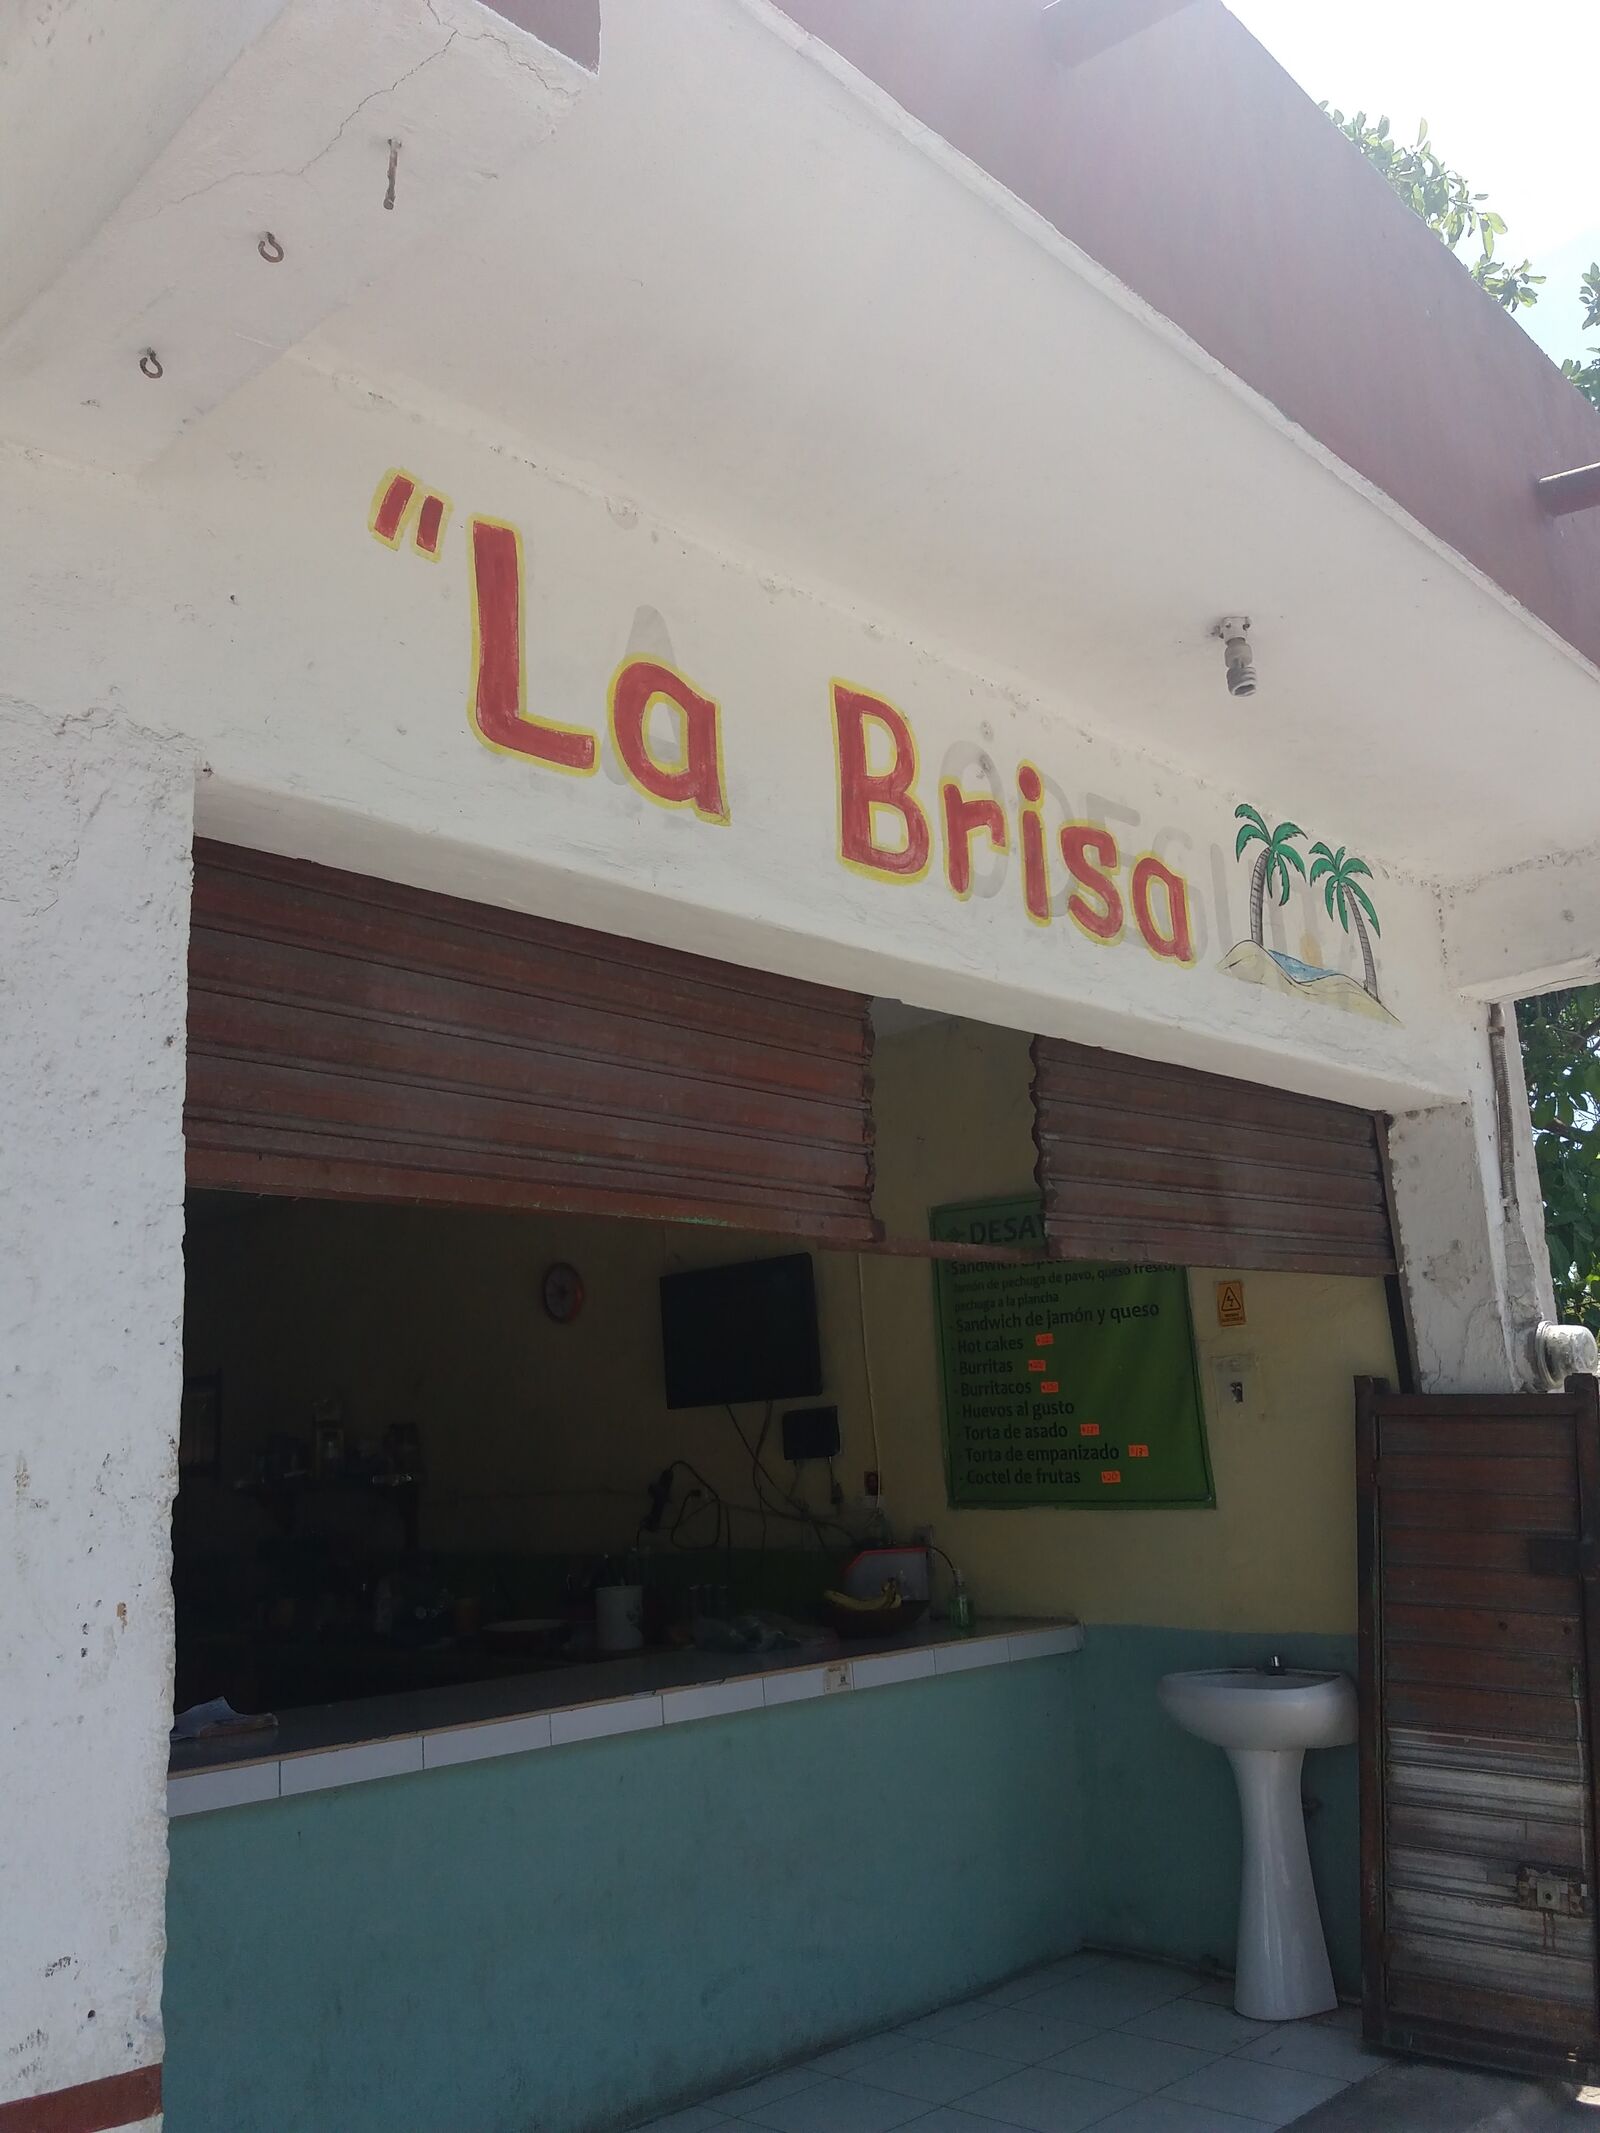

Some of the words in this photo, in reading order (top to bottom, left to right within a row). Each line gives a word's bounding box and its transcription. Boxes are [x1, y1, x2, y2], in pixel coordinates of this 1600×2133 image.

[829, 676, 1197, 968] Brisa
[986, 1279, 1000, 1290] de
[1002, 1275, 1046, 1292] pechuga
[1047, 1271, 1062, 1284] de
[1097, 1265, 1131, 1281] queso
[954, 1299, 996, 1313] pechuga
[998, 1297, 1005, 1307] a
[1006, 1295, 1016, 1307] la
[1017, 1291, 1059, 1309] plancha
[956, 1310, 1022, 1333] Sandwich
[1025, 1310, 1043, 1326] de
[1046, 1307, 1093, 1330] jamón
[1097, 1308, 1106, 1326] y
[1110, 1302, 1160, 1323] queso
[957, 1338, 982, 1354] Hot
[985, 1335, 1024, 1352] cakes
[959, 1358, 1014, 1376] Burritas
[960, 1380, 1032, 1397] Burritacos
[962, 1403, 1013, 1419] Huevos
[1016, 1401, 1029, 1417] al
[1032, 1400, 1075, 1420] gusto
[964, 1424, 1001, 1440] Torta
[1003, 1423, 1021, 1439] de
[1025, 1421, 1068, 1439] asado
[965, 1446, 1002, 1463] Torta
[1005, 1445, 1023, 1462] de
[1026, 1442, 1120, 1465] empanizado
[967, 1468, 1011, 1484] Coctel
[1014, 1468, 1033, 1483] de
[1036, 1467, 1081, 1484] frutas
